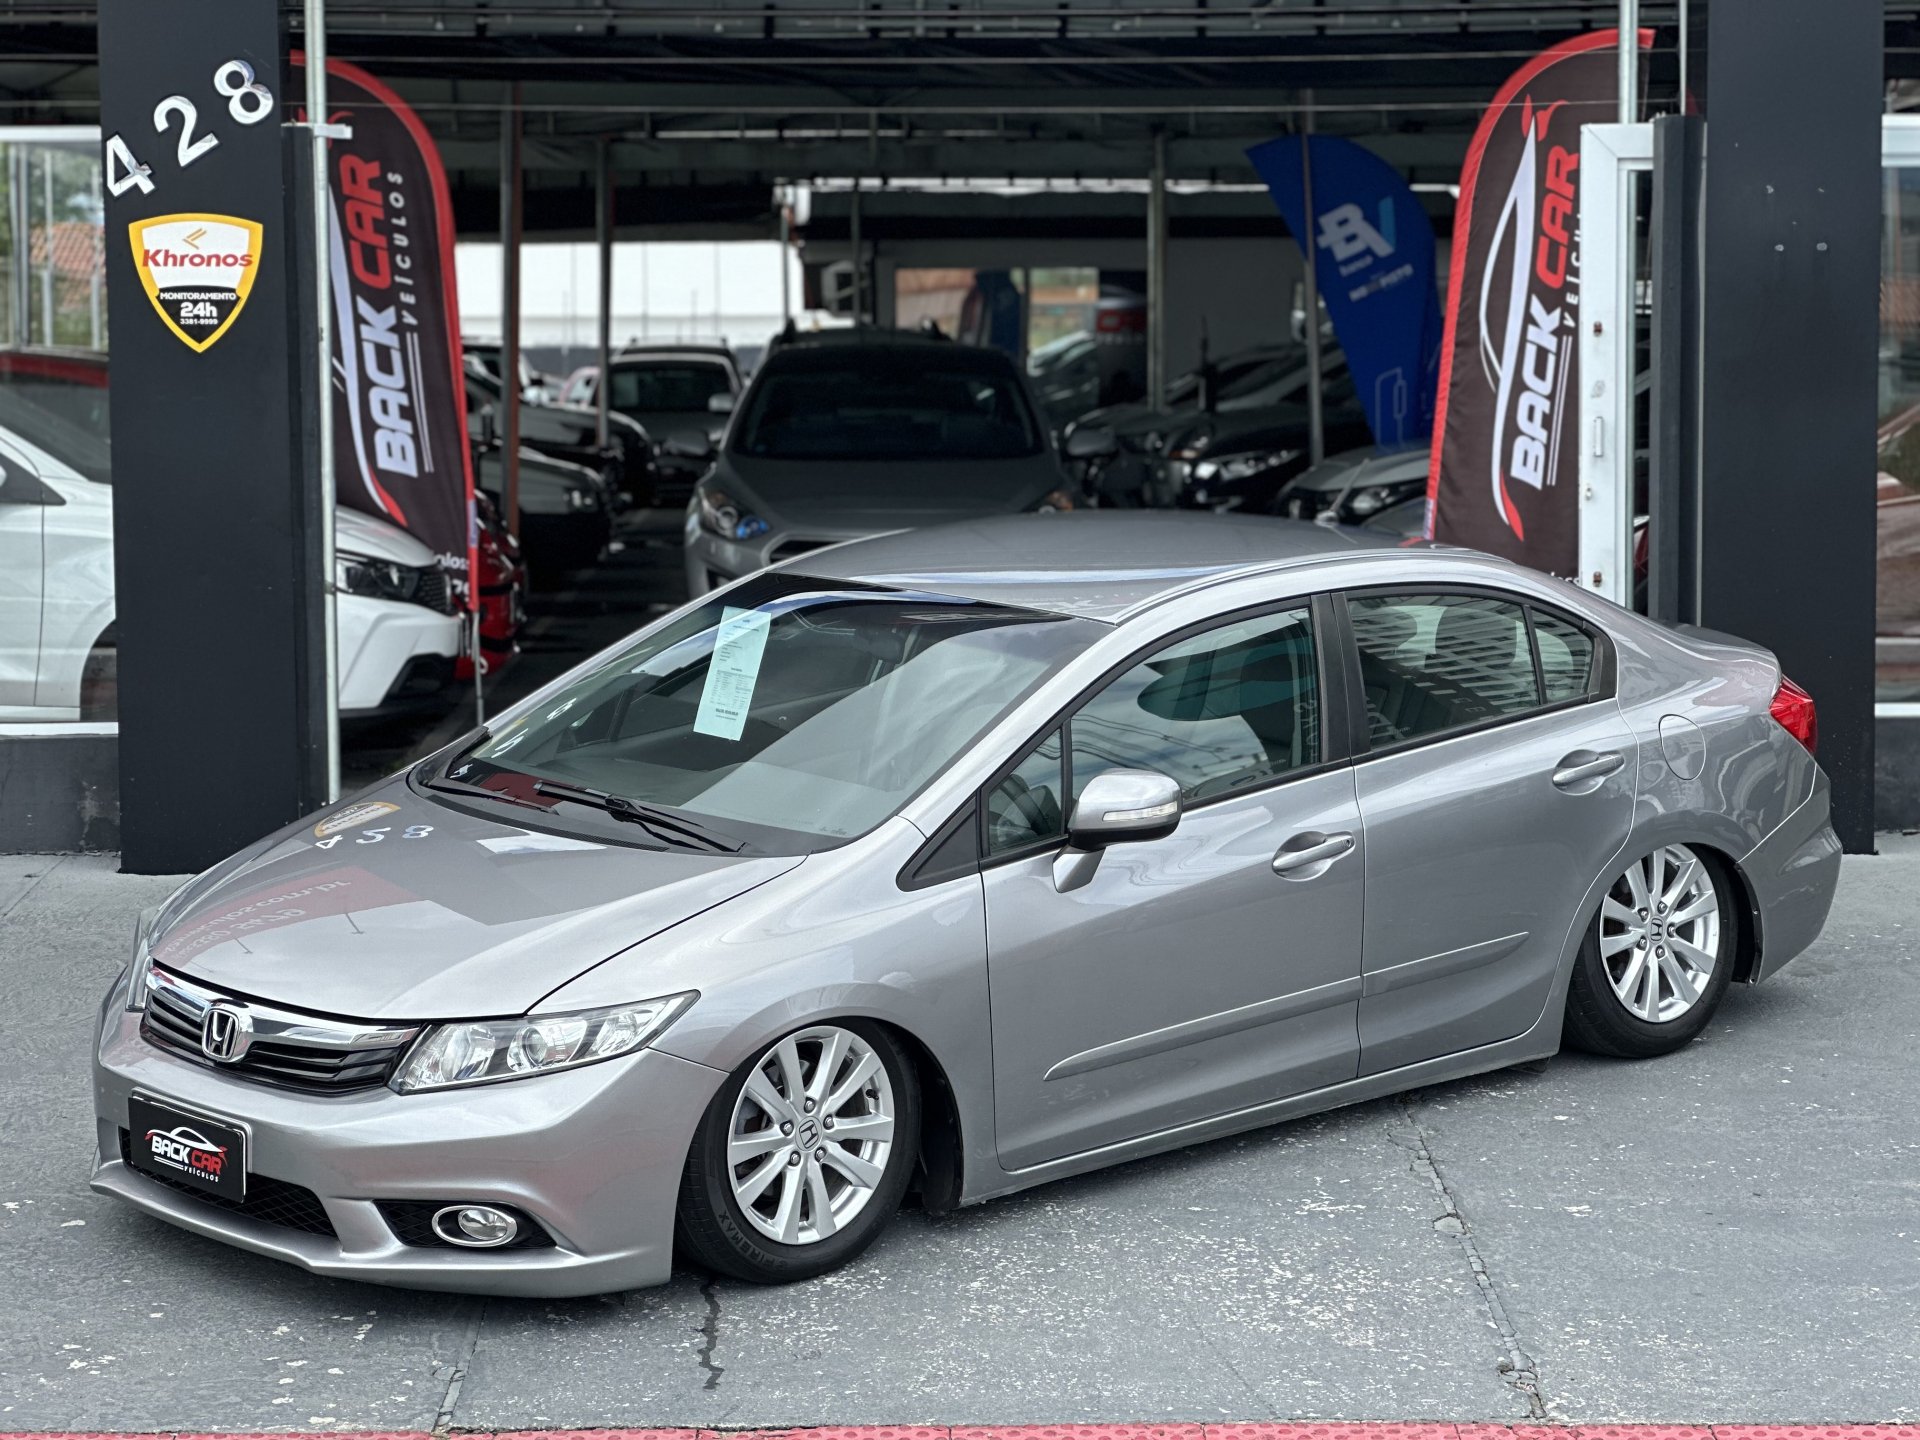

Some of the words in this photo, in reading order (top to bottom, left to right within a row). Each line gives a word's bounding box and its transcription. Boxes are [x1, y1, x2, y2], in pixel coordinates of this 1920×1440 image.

[142, 249, 253, 267] Khronos
[339, 154, 392, 290] CAR
[1535, 145, 1580, 289] CAR
[160, 292, 237, 300] MONITORAMENTO
[180, 301, 218, 318] 24h
[355, 294, 418, 478] BACK
[1510, 293, 1562, 491] BACK
[151, 1136, 191, 1164] BACK
[191, 1149, 223, 1175] CAR
